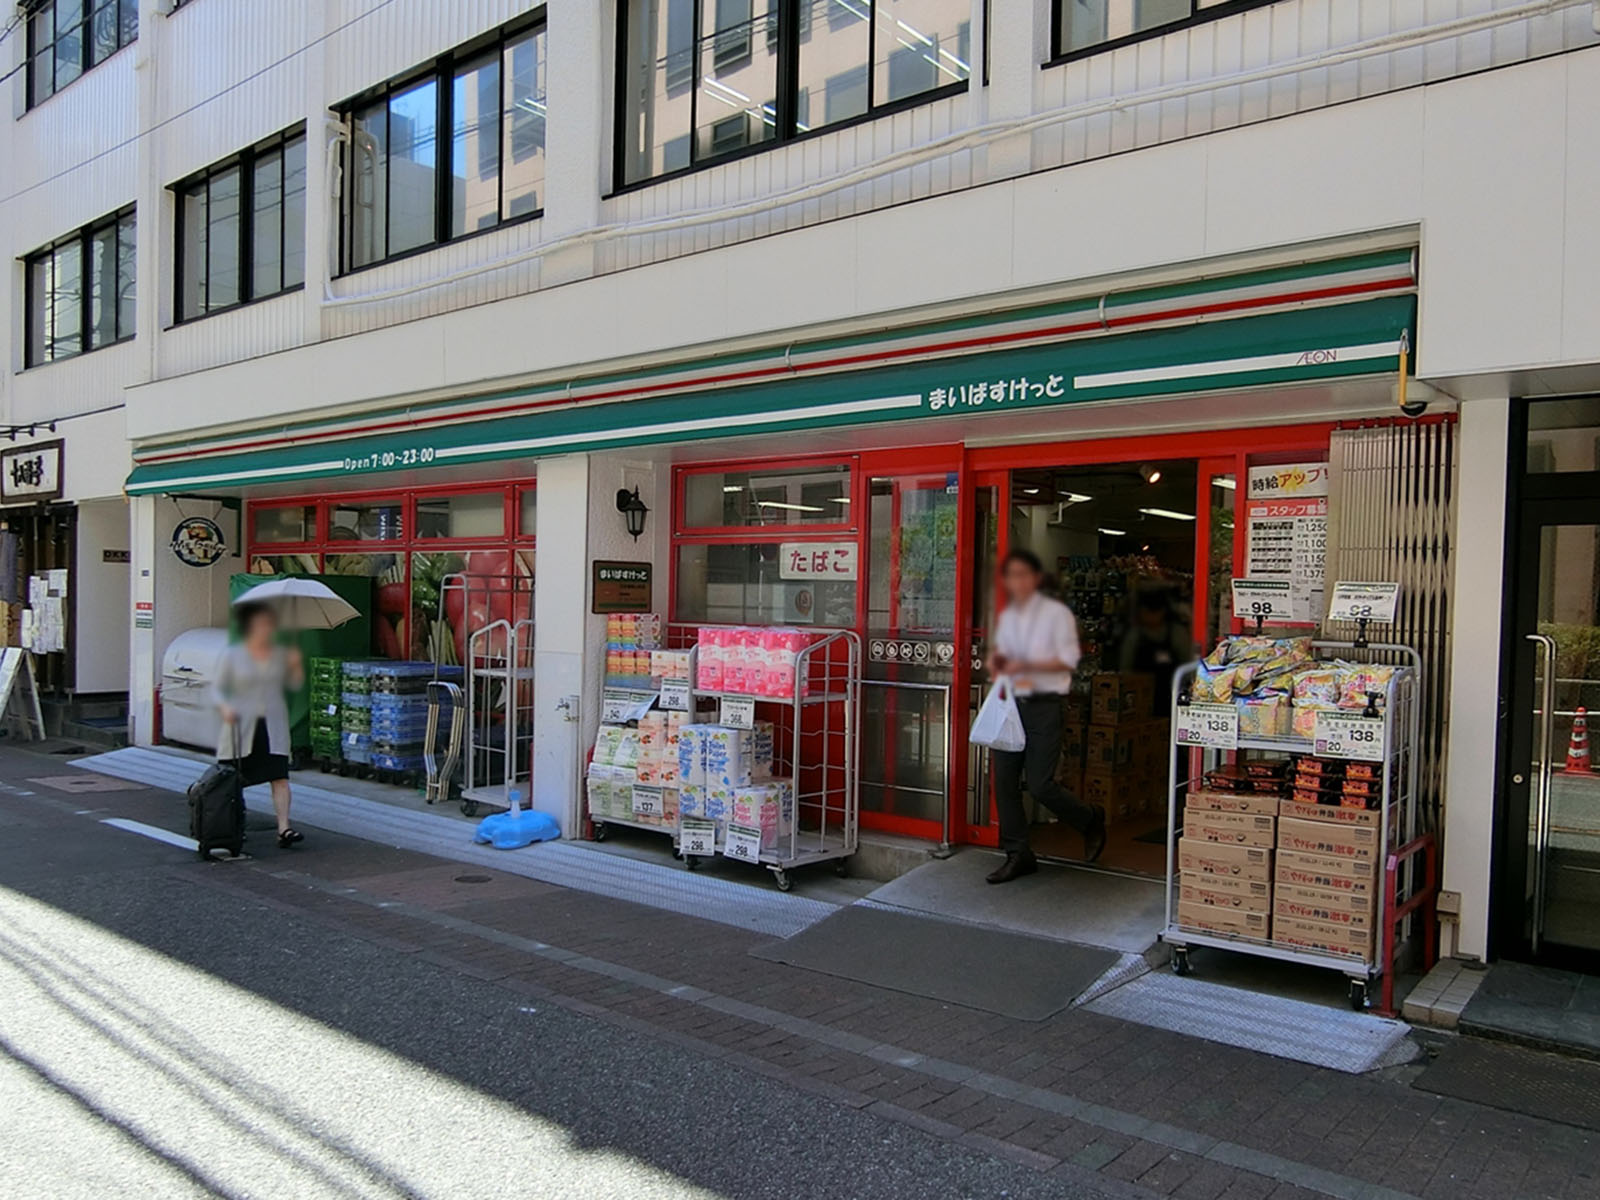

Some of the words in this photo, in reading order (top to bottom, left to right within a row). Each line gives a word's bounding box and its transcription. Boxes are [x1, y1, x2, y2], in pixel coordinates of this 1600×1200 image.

[928, 373, 1065, 411] まいばすけっと
[344, 457, 370, 471] Open
[790, 549, 850, 573] たばこ
[1251, 602, 1273, 614] 98
[1207, 720, 1230, 732] 138
[1188, 730, 1201, 740] 20
[1349, 729, 1374, 742] 138
[1327, 741, 1341, 751] 20
